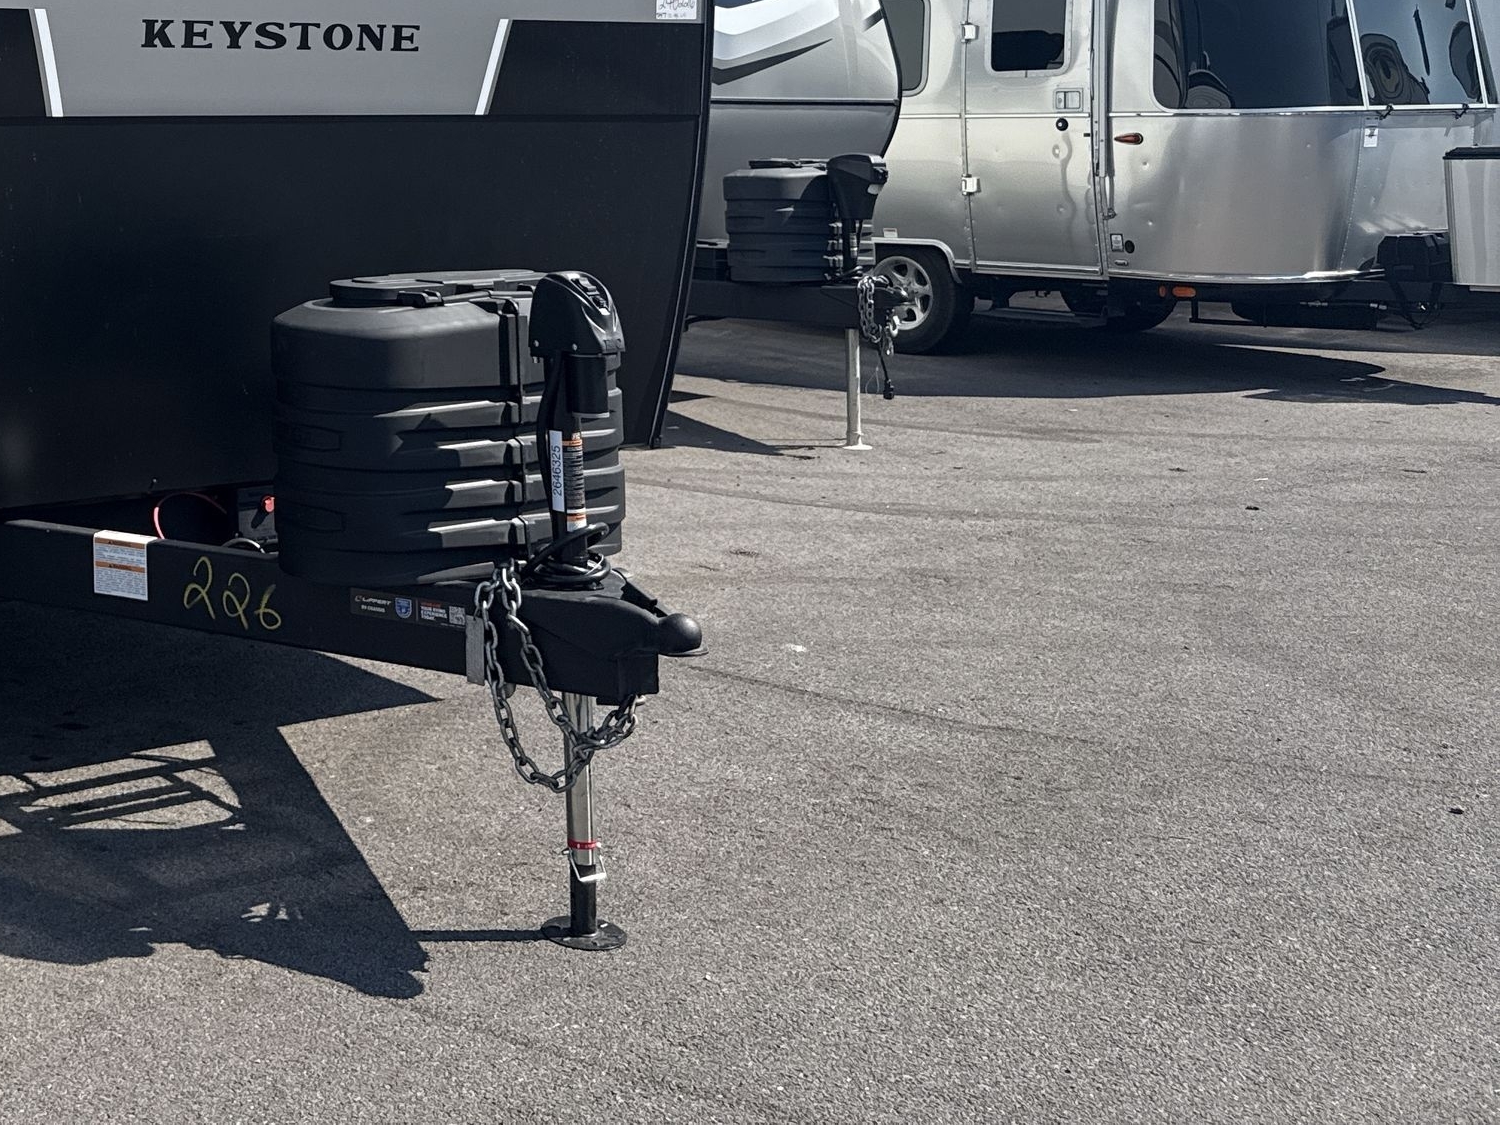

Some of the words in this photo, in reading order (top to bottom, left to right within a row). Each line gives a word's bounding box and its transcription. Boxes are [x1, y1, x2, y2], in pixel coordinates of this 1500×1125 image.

[140, 18, 421, 52] KEYSTONE
[551, 445, 563, 496] 2646325
[183, 556, 282, 630] 226
